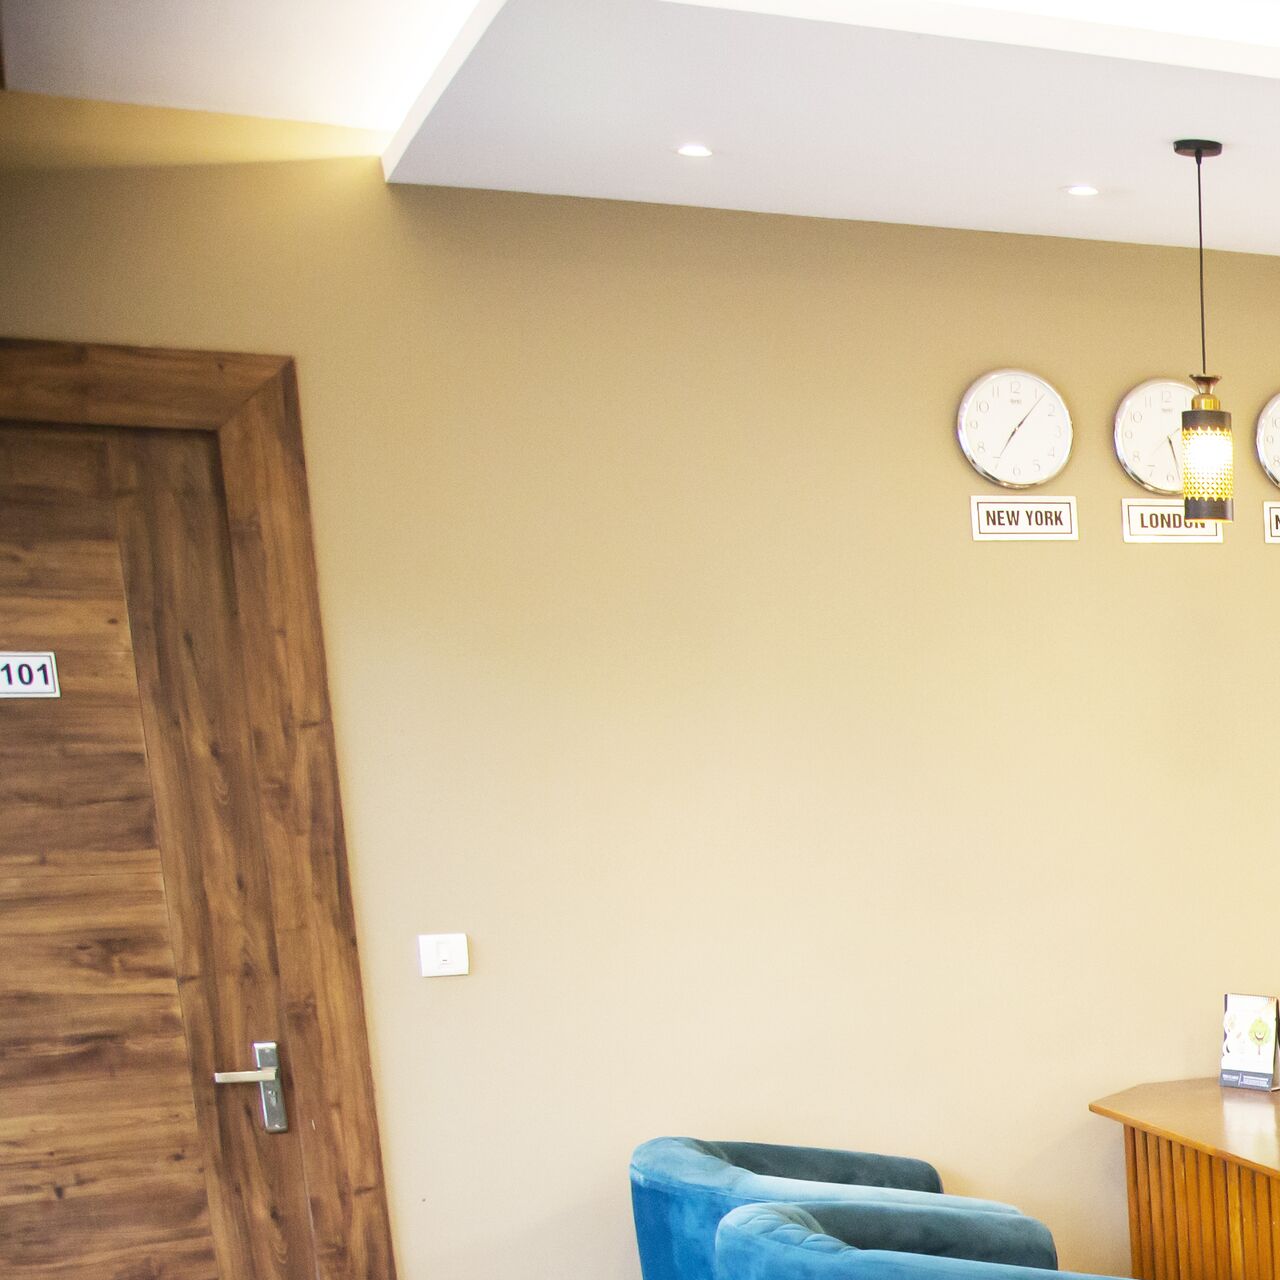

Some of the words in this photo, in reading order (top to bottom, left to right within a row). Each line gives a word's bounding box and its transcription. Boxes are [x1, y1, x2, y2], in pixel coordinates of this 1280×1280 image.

[986, 510, 1020, 527] NEW
[1026, 510, 1064, 527] YORK
[0, 663, 50, 686] 101
